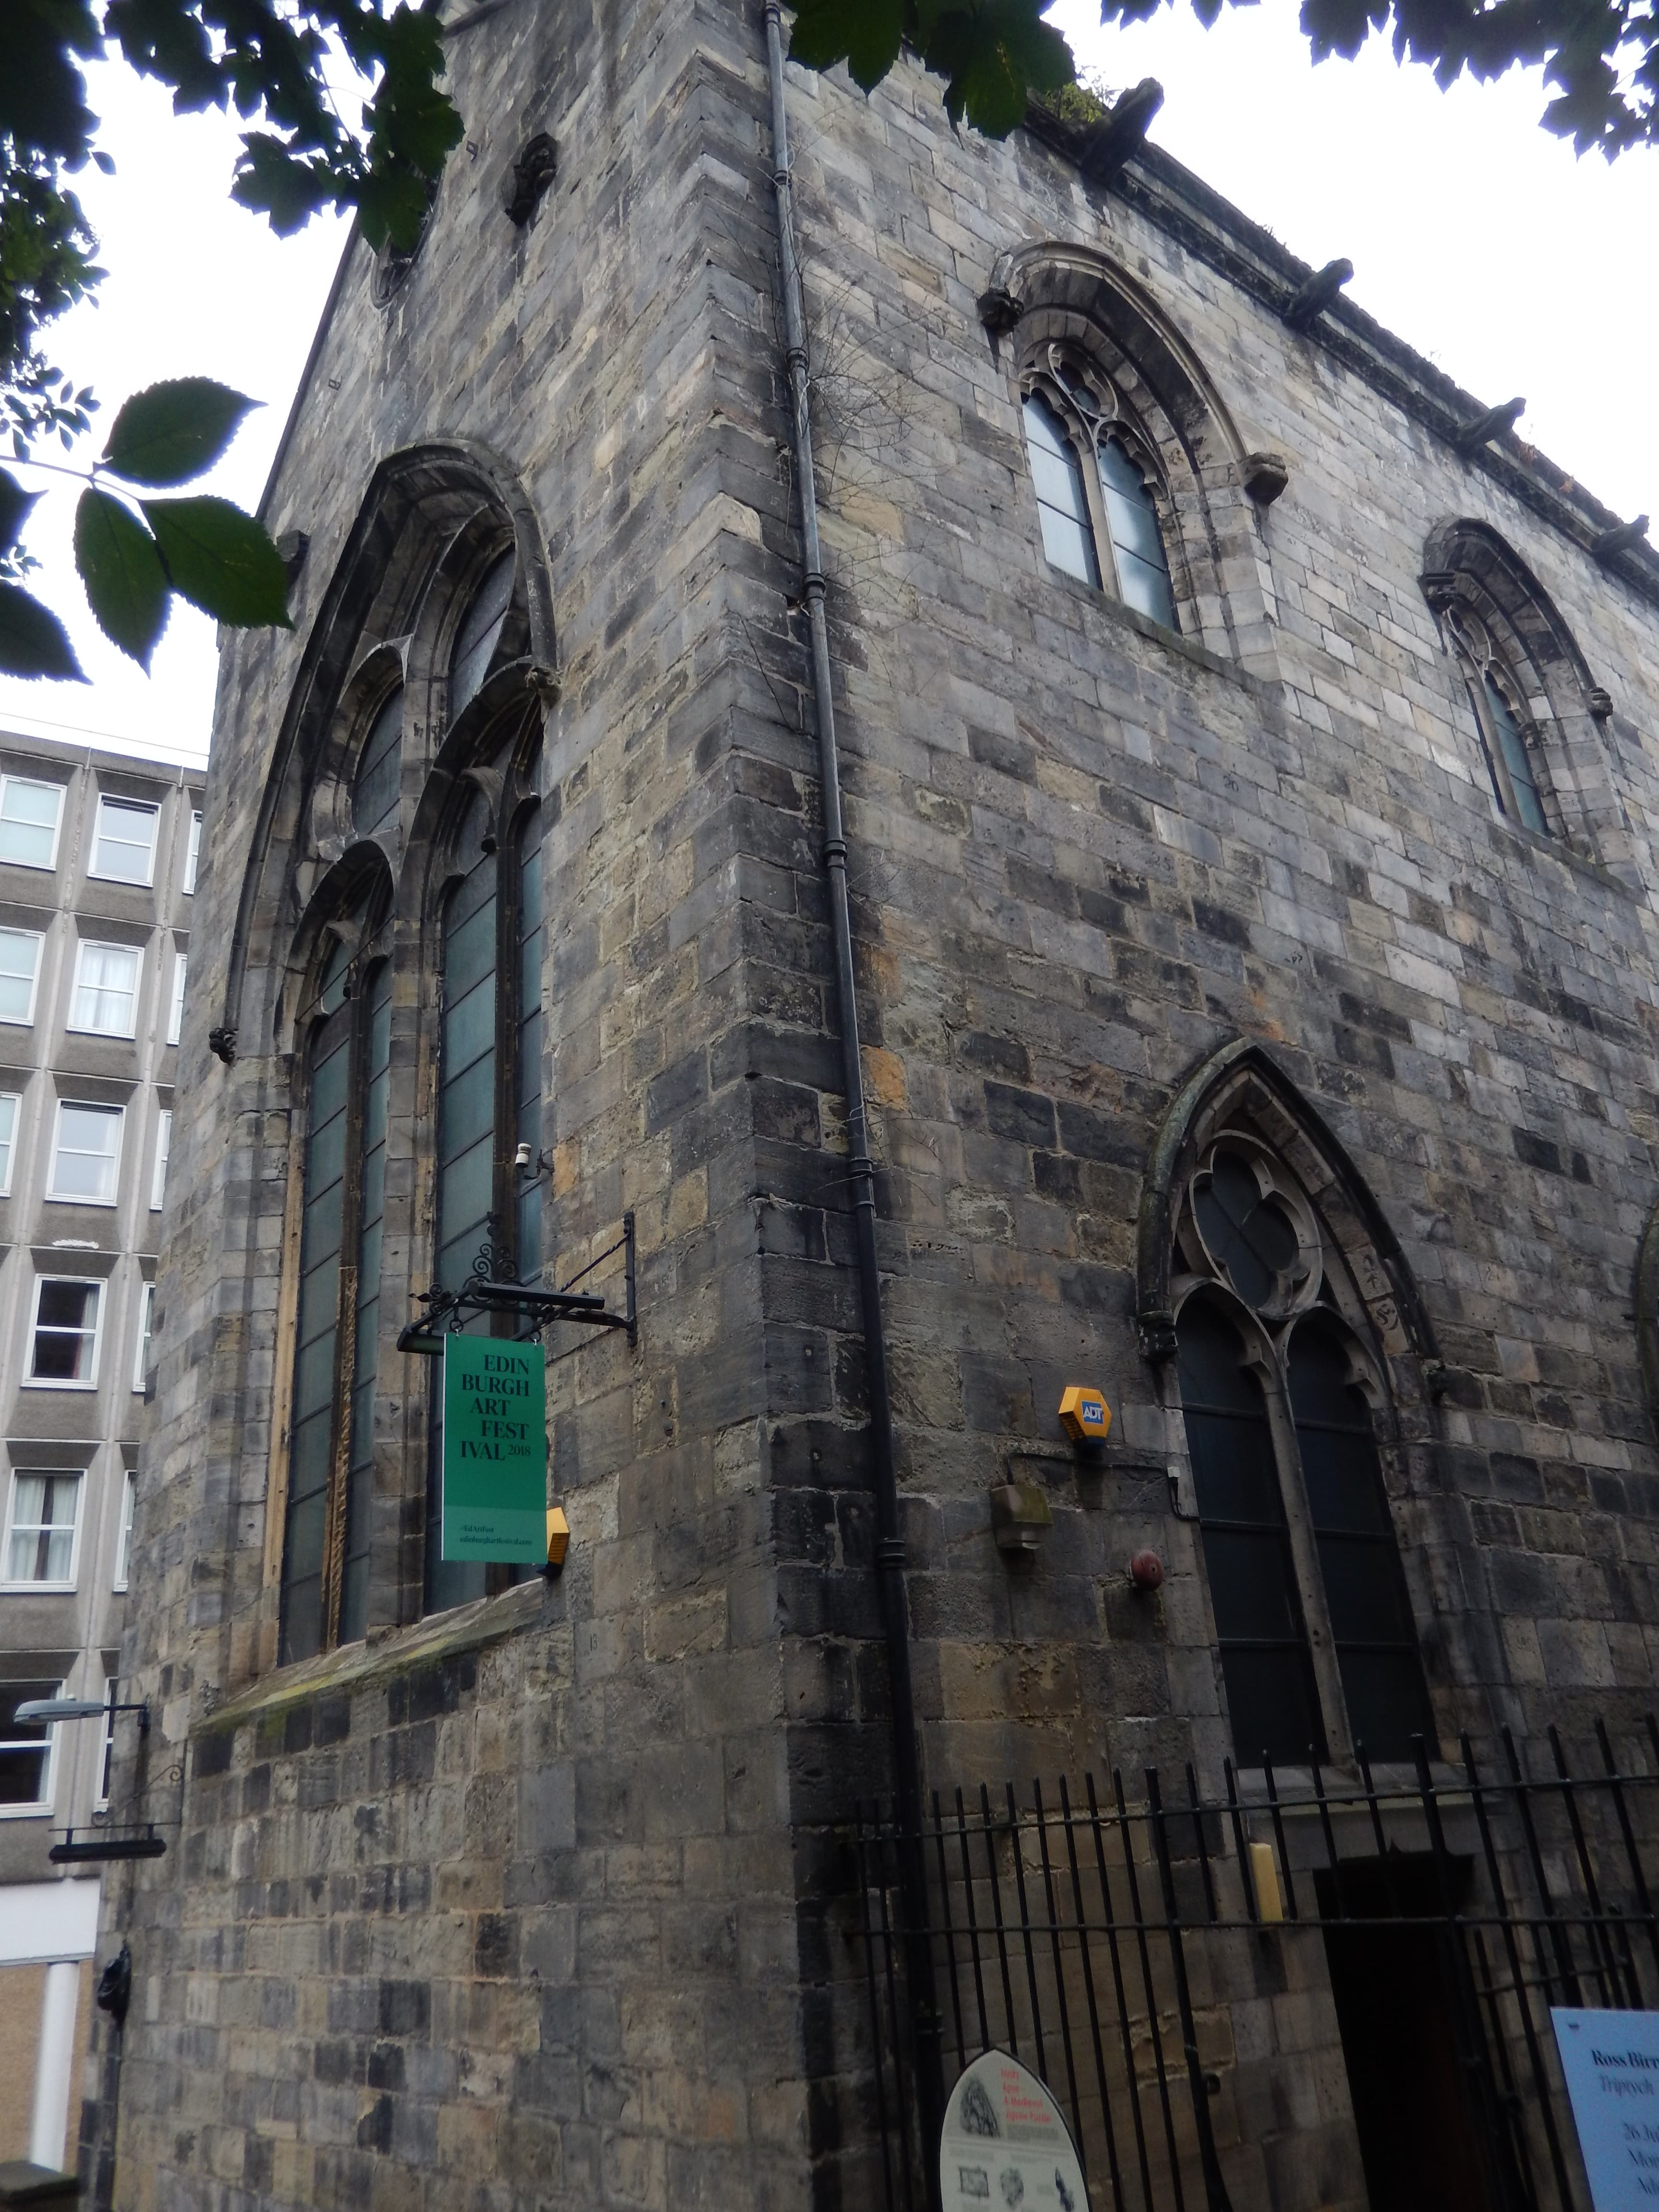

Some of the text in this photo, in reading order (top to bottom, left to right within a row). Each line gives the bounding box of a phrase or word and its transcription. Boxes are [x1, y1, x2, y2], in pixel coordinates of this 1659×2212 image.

[484, 1354, 529, 1375] EDIN
[462, 1373, 530, 1396] BURGH
[470, 1397, 511, 1416] ART
[1083, 1406, 1102, 1420] ADT
[481, 1420, 529, 1440] FEST
[461, 1441, 530, 1461] IVAL 2018
[1591, 2050, 1627, 2067] Ross
[1599, 2074, 1655, 2097] Triptych
[1643, 2123, 1659, 2142] Ju
